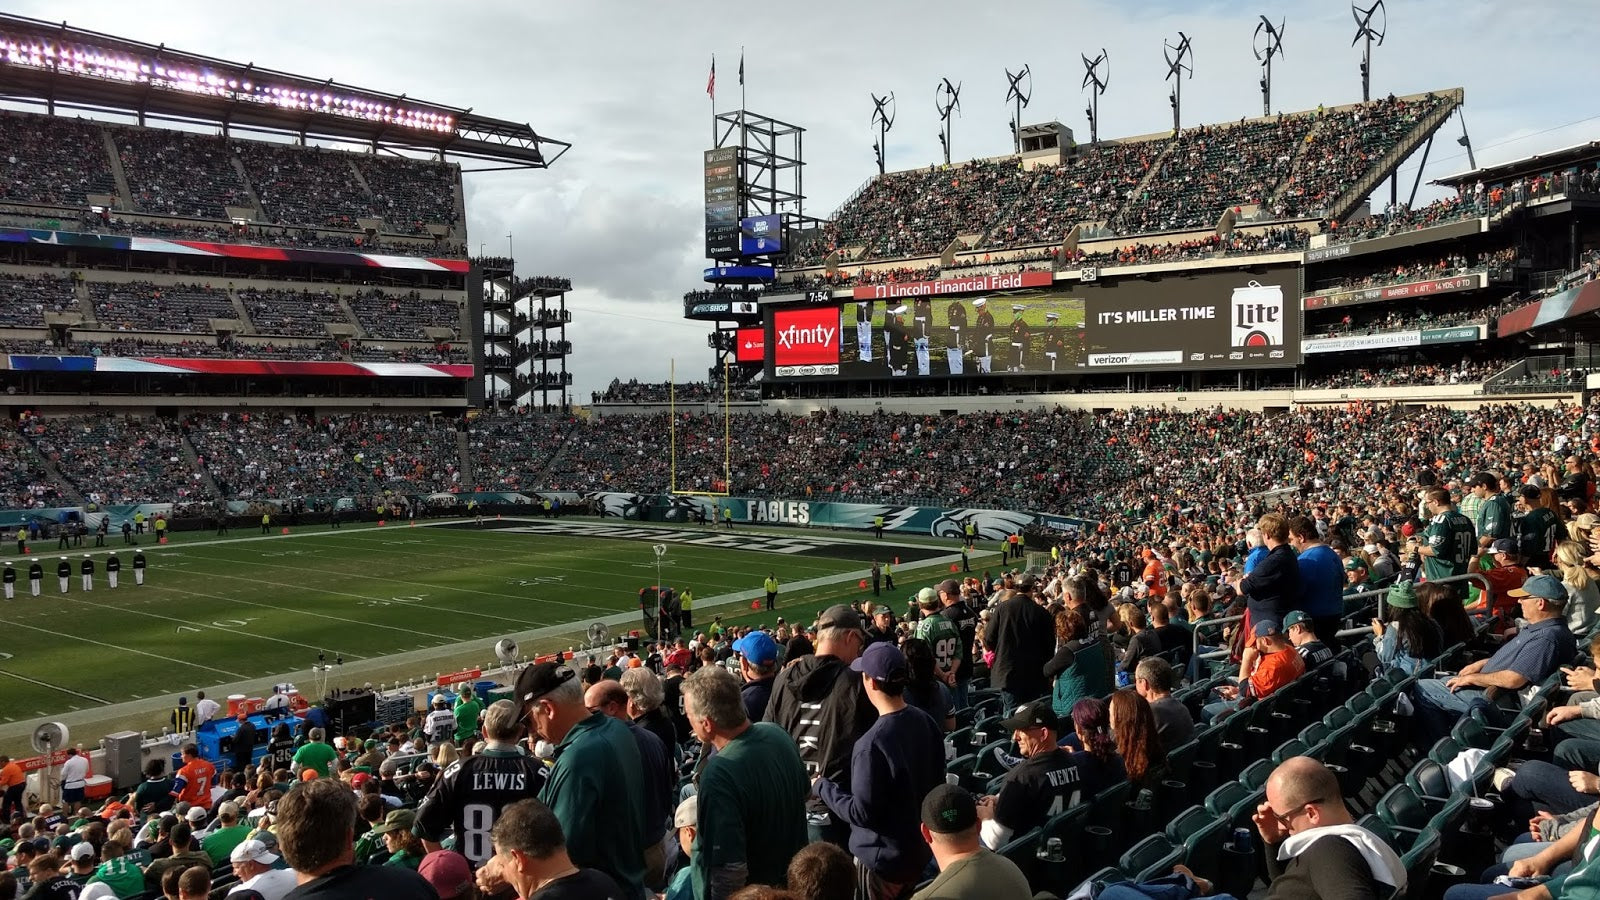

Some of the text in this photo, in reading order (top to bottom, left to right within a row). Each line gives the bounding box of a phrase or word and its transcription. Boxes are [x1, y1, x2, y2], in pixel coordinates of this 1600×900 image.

[890, 274, 1022, 297] Lincoln Financial Field
[1387, 287, 1409, 297] BARBER
[809, 291, 829, 302] 7:54
[1098, 306, 1216, 325] IT'S MILLER TIME
[1235, 303, 1280, 330] Lite
[778, 323, 836, 349] xfinity
[1386, 335, 1418, 343] CALENDAR
[1094, 355, 1128, 365] verizon
[1120, 571, 1129, 582] 91
[935, 638, 957, 668] 99
[276, 748, 292, 762] 36
[472, 773, 525, 790] LEWIS
[1045, 765, 1081, 787] WENTZ
[196, 776, 207, 796] 7
[104, 856, 128, 876] 11
